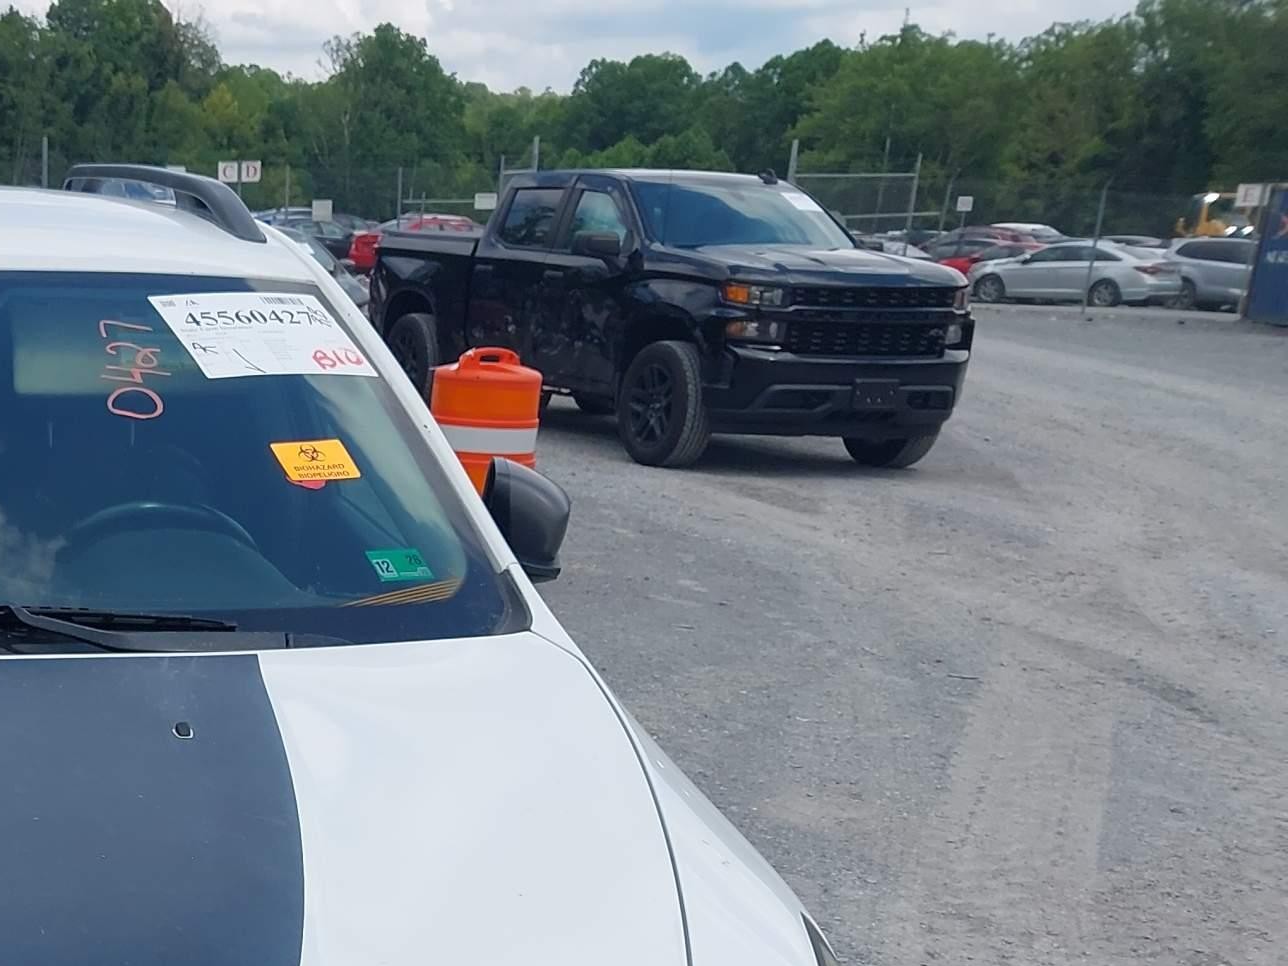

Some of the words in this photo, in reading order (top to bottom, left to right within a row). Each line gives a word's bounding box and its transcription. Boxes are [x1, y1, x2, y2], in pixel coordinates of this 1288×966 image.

[246, 164, 257, 178] D
[184, 308, 313, 327] 45560427
[293, 463, 345, 472] BIOHAZARD
[297, 470, 351, 479] BIOPELIGRO
[374, 560, 394, 573] 12
